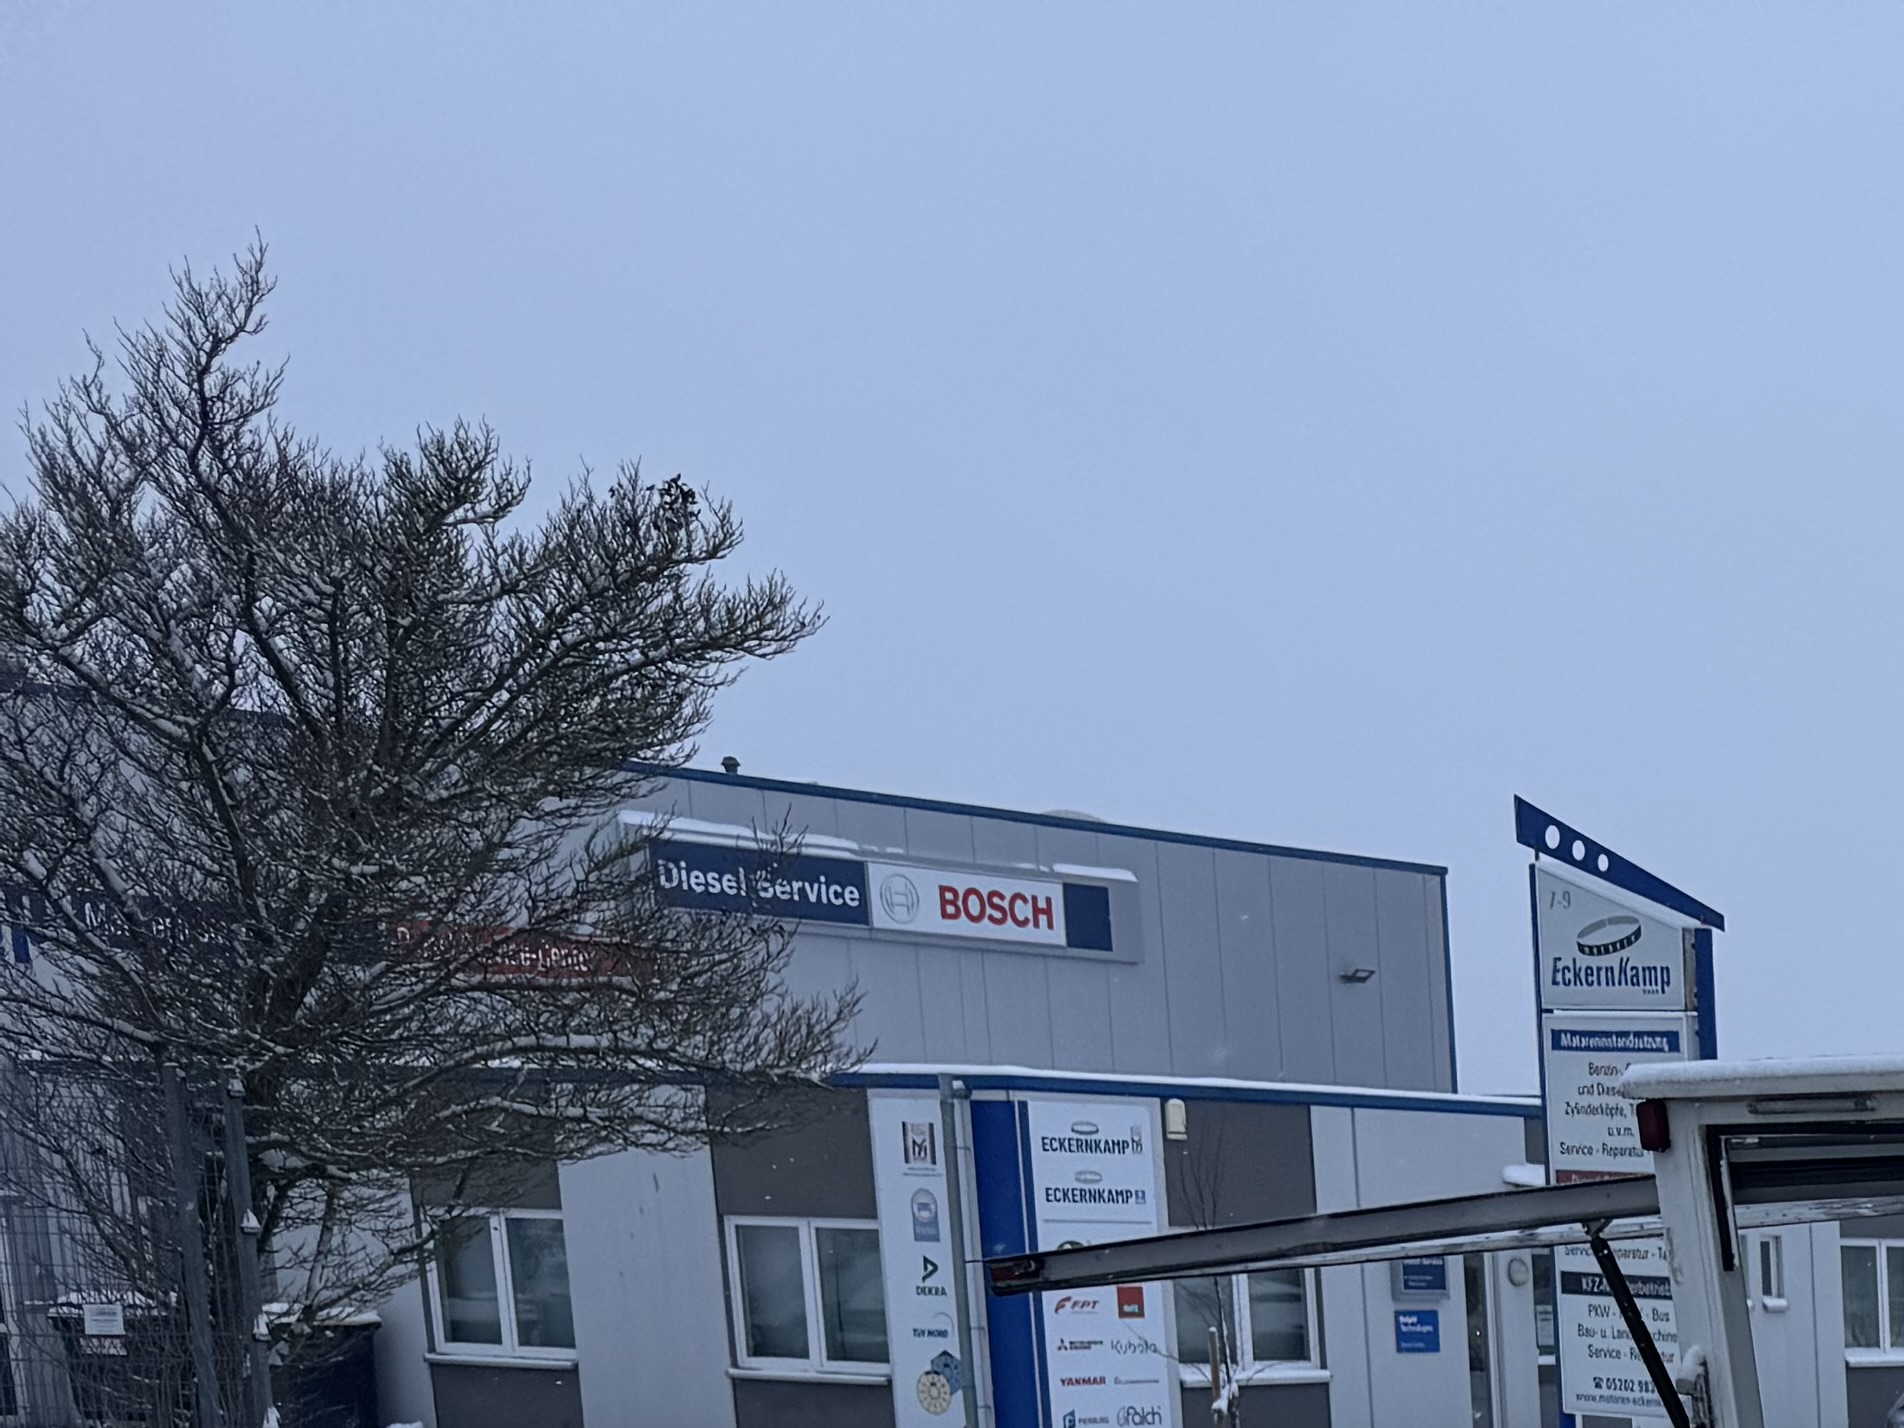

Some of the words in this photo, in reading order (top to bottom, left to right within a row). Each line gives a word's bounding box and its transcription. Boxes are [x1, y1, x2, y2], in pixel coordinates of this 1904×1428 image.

[657, 858, 747, 897] Diesel
[757, 870, 860, 907] Service
[938, 885, 1055, 931] BOSCH
[1552, 956, 1671, 994] EckernKamp
[1041, 1136, 1130, 1155] ECKERNKAMP
[1045, 1187, 1134, 1205] ECKERNKAMP
[915, 1285, 948, 1297] DEKRA
[1060, 1376, 1107, 1387] YANMAR
